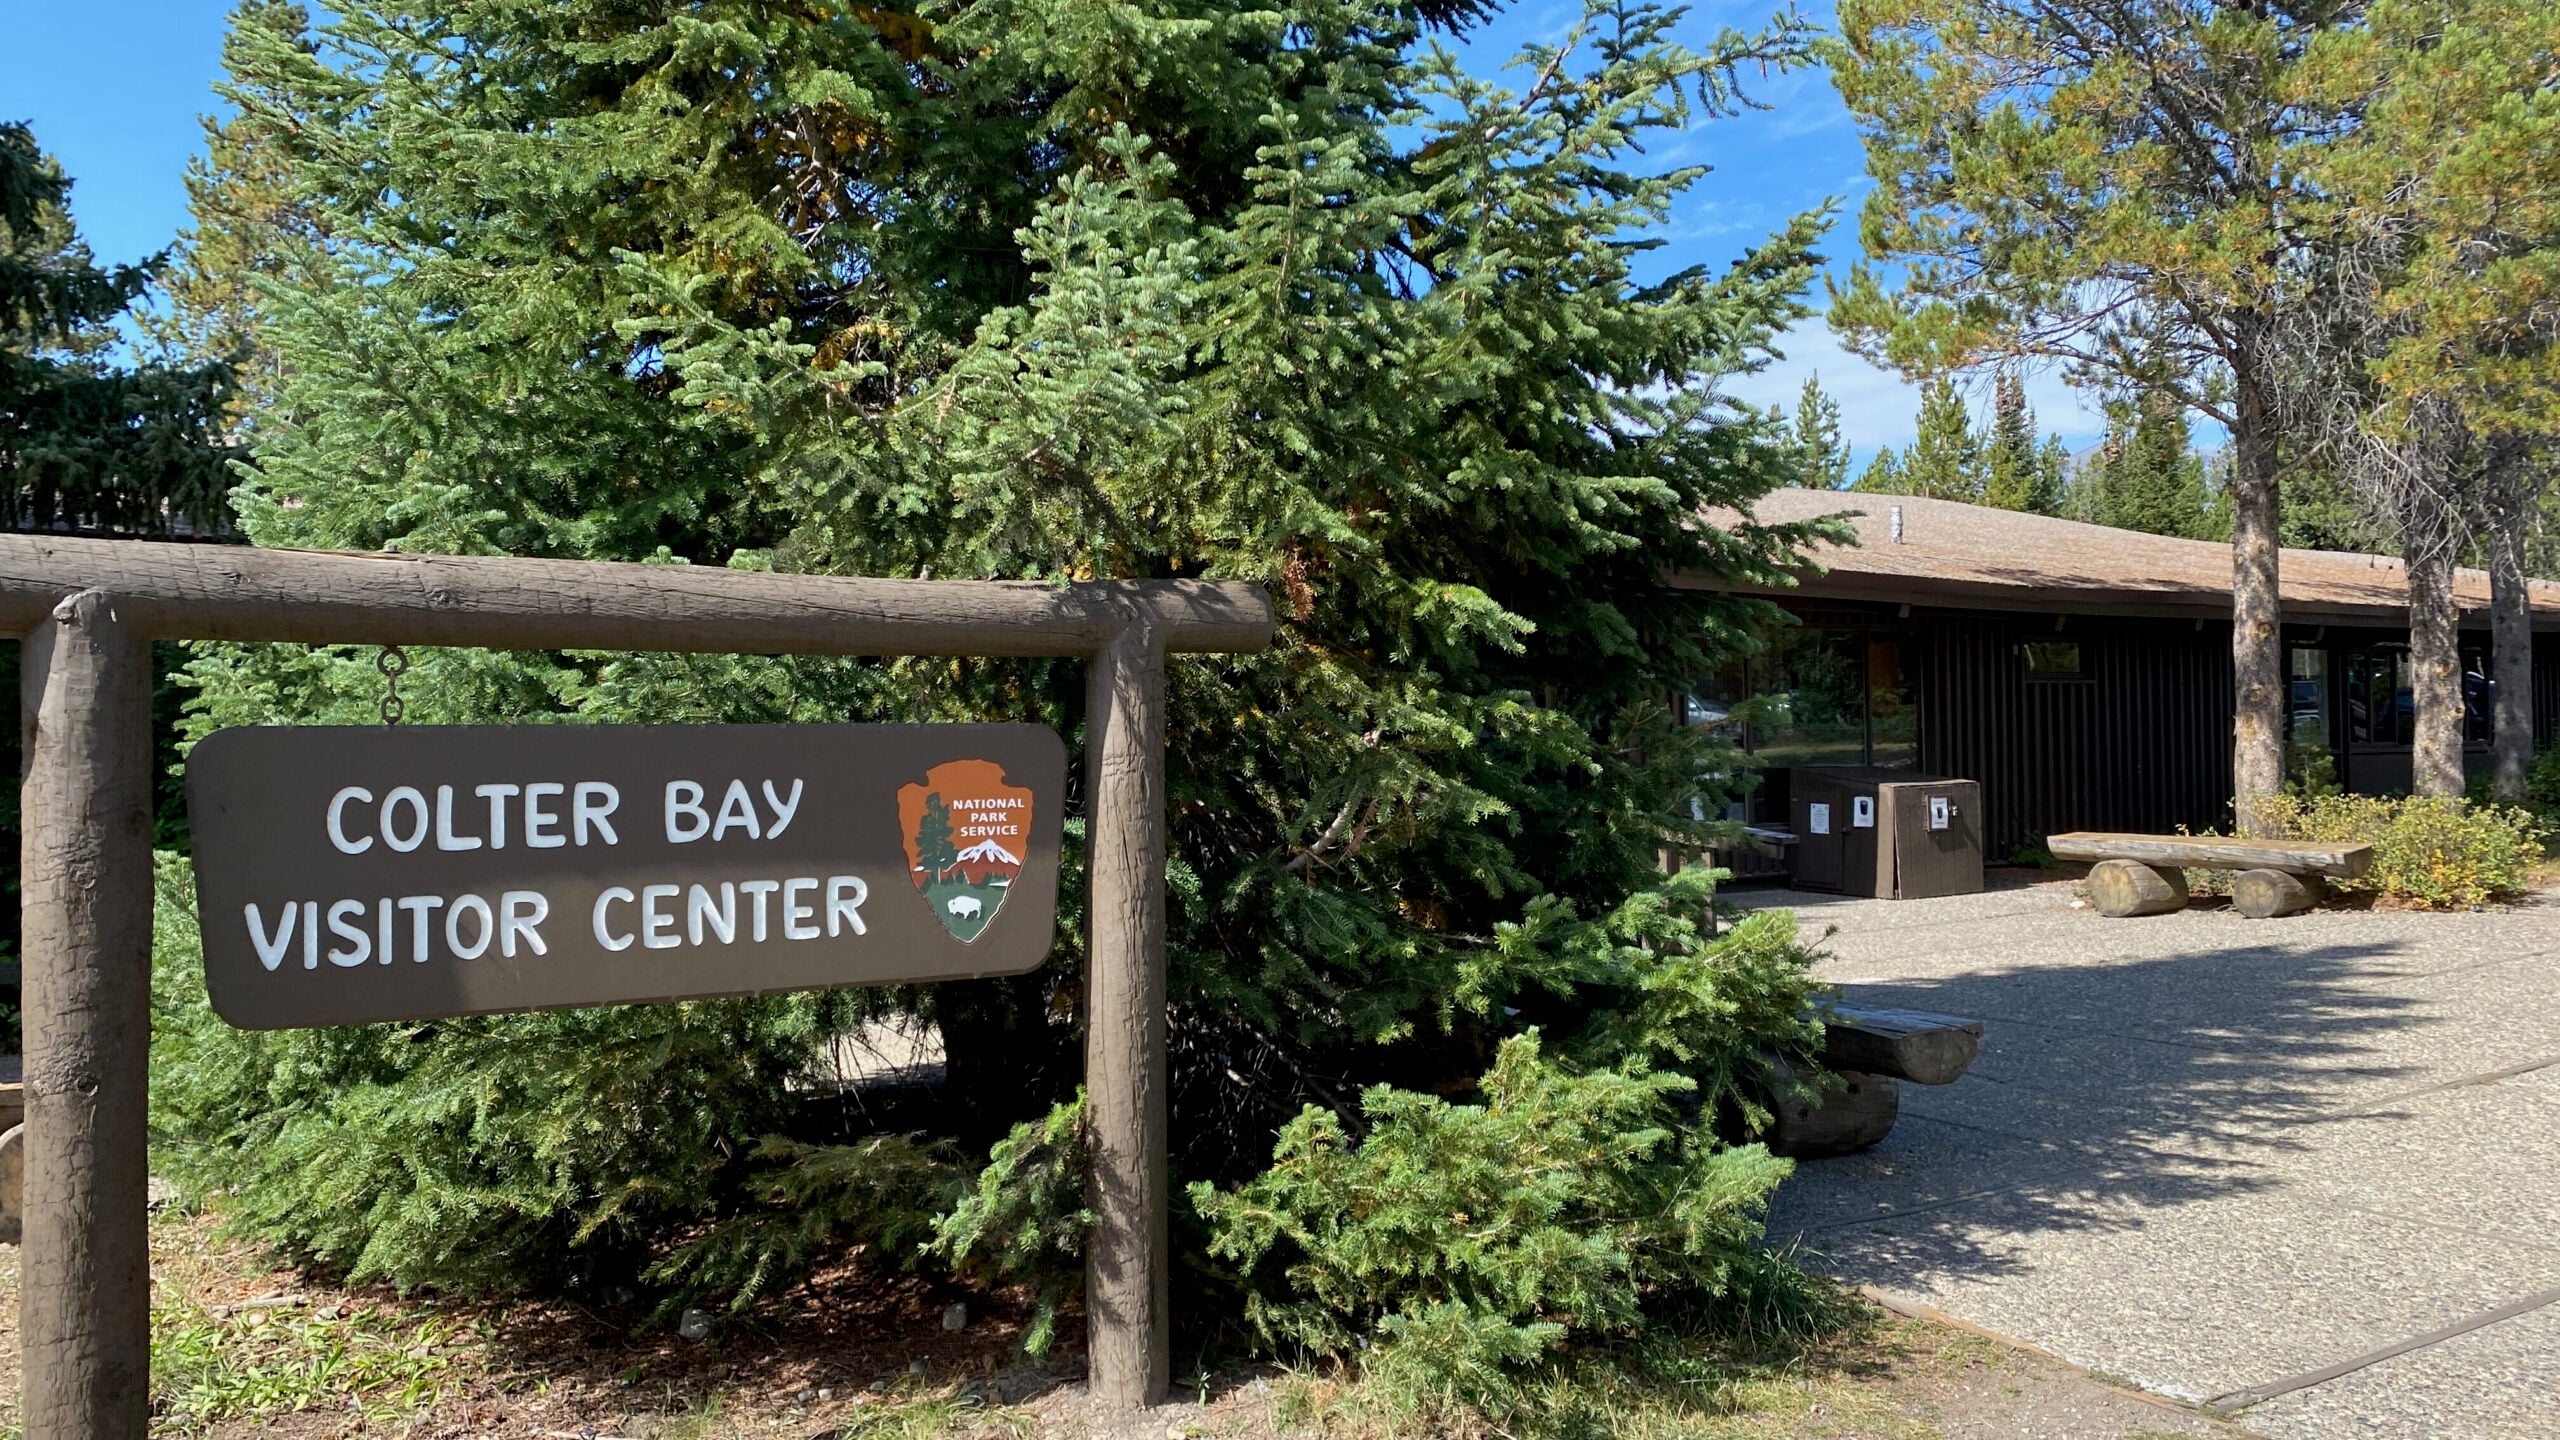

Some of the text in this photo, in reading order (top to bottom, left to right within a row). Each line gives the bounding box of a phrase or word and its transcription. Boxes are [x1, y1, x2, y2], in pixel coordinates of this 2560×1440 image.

[952, 798, 1025, 810] NATIONAL
[327, 778, 804, 855] COLTER BAY
[970, 812, 1008, 823] PARK
[959, 824, 1019, 837] SERVICE
[244, 875, 868, 971] VISITOR CENTER
